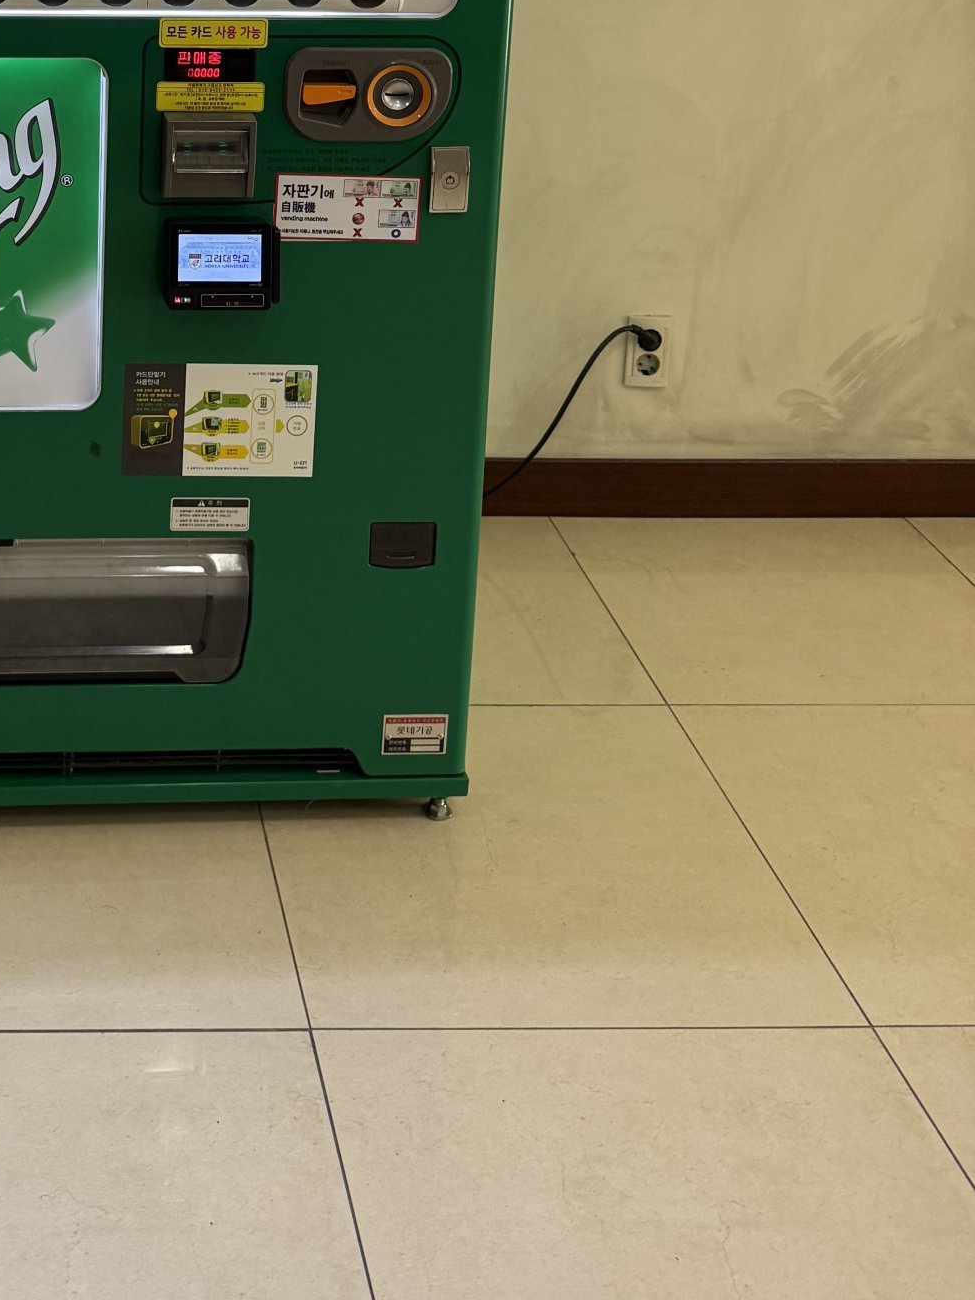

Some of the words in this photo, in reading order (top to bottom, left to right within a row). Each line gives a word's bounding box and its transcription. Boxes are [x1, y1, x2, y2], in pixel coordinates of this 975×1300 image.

[166, 26, 188, 38] 모든
[191, 26, 212, 39] 카드
[215, 26, 236, 39] 사용
[241, 26, 262, 39] 가능
[177, 51, 222, 65] 판매중
[188, 68, 220, 78] 00000
[282, 183, 335, 199] 자판기에
[281, 201, 316, 213] 自販機
[204, 254, 250, 263] 고려대학교
[397, 726, 433, 735] 롯데기공
